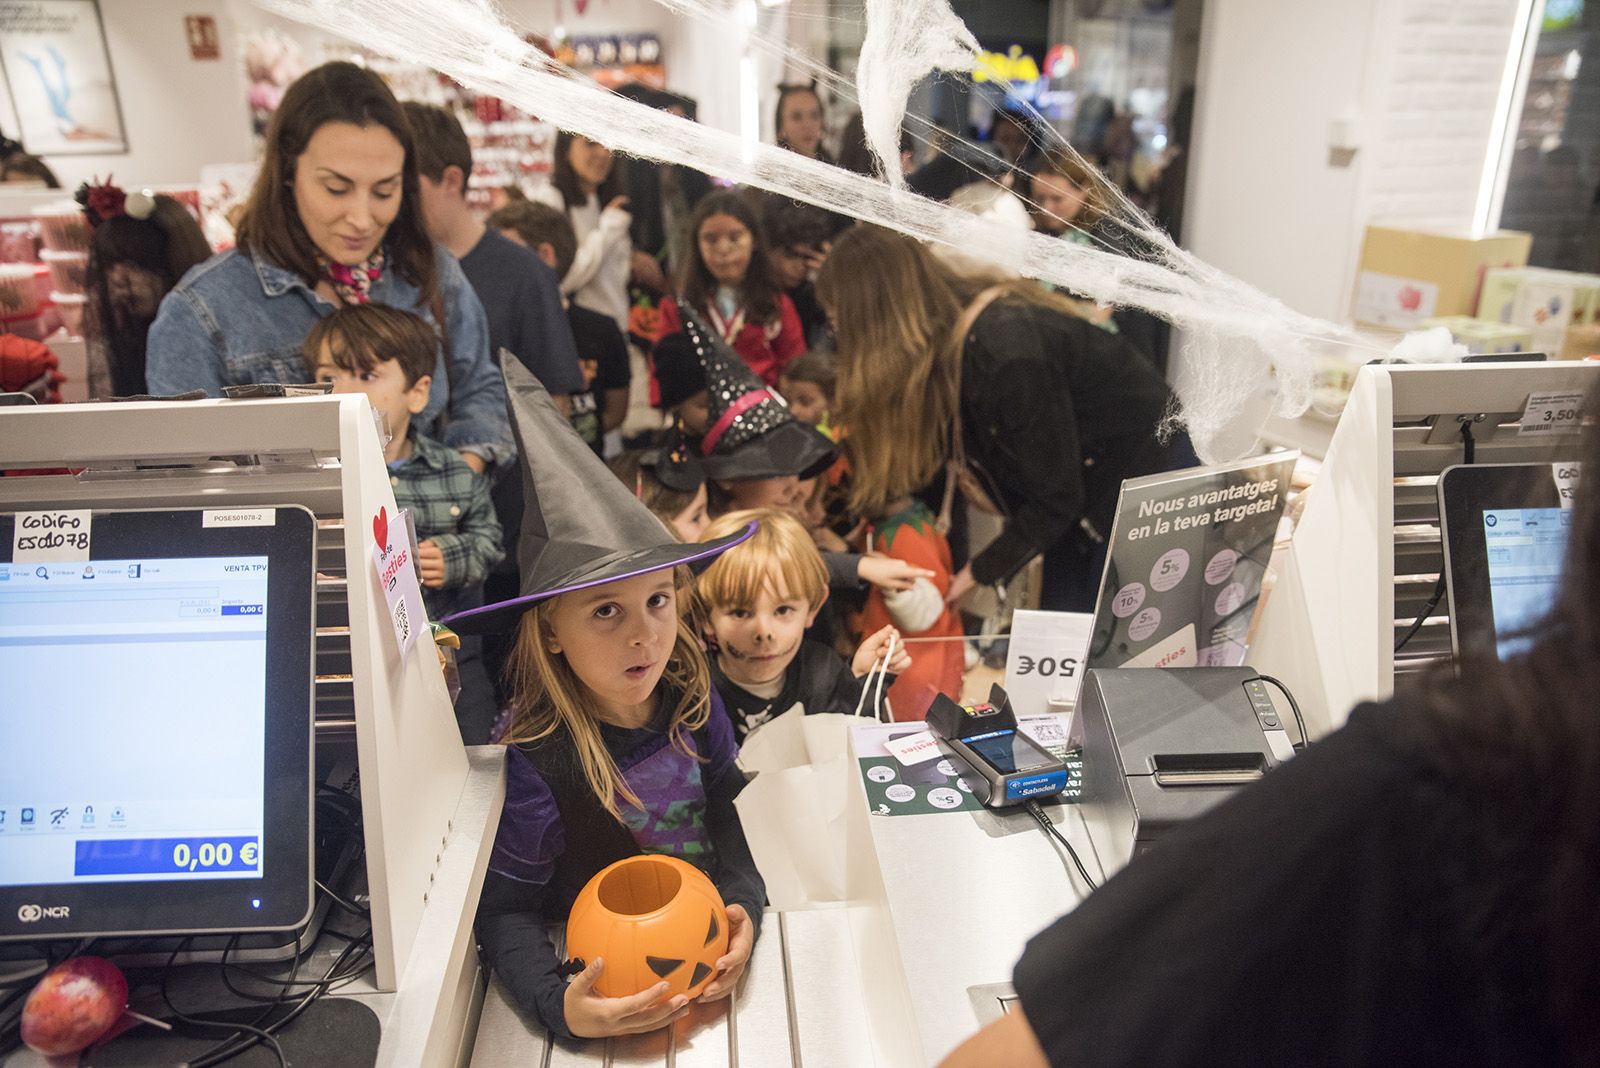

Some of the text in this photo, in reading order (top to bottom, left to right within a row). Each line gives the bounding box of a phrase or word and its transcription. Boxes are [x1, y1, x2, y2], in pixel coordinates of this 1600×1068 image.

[1138, 478, 1279, 518] Nous avantatges
[1127, 494, 1279, 541] en la teva targeta!
[224, 563, 267, 573] VENTA TPV
[240, 606, 256, 614] 0,00
[1022, 783, 1056, 796] Sabadell
[173, 841, 259, 872] 0,00 €
[43, 905, 70, 918] NCR
